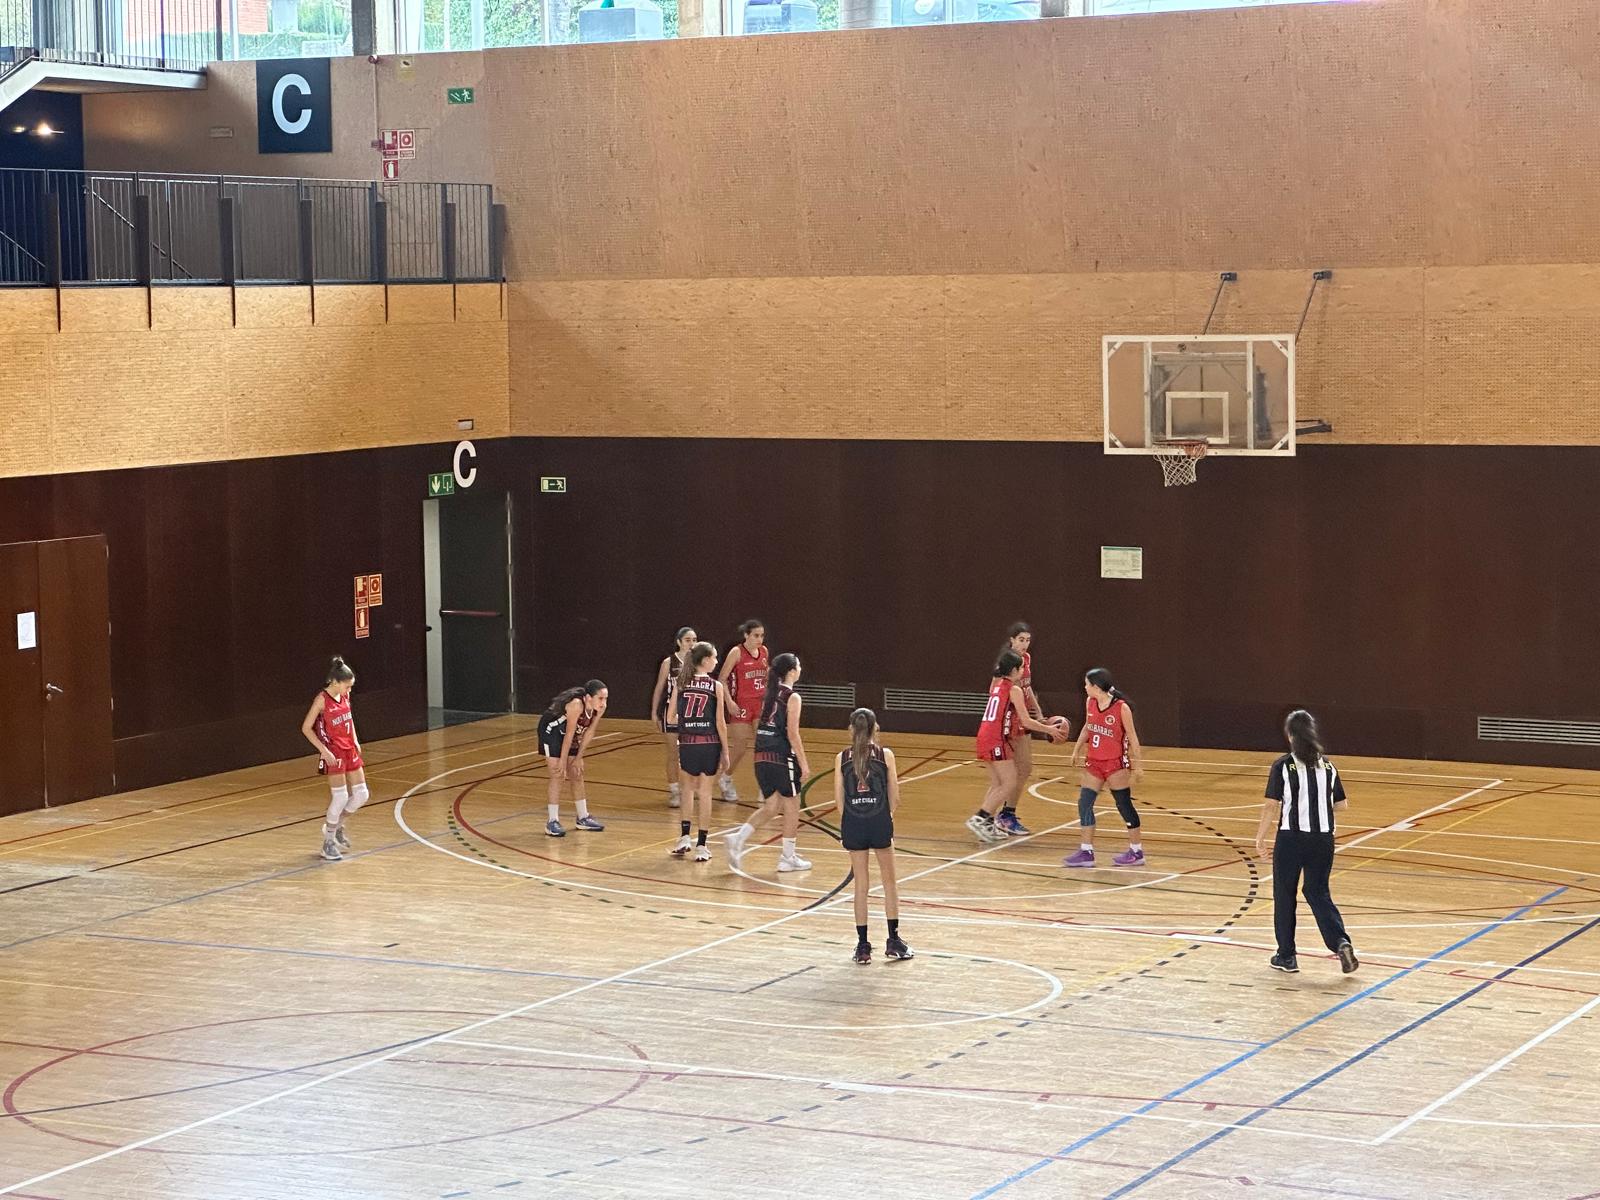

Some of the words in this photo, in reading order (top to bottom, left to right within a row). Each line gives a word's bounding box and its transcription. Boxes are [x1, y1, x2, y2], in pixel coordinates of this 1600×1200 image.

[271, 73, 312, 135] C
[453, 440, 477, 488] C
[686, 680, 714, 691] LAGRA
[683, 692, 708, 717] 77
[982, 696, 1000, 722] 10
[345, 722, 350, 734] 7
[1092, 734, 1100, 748] 9
